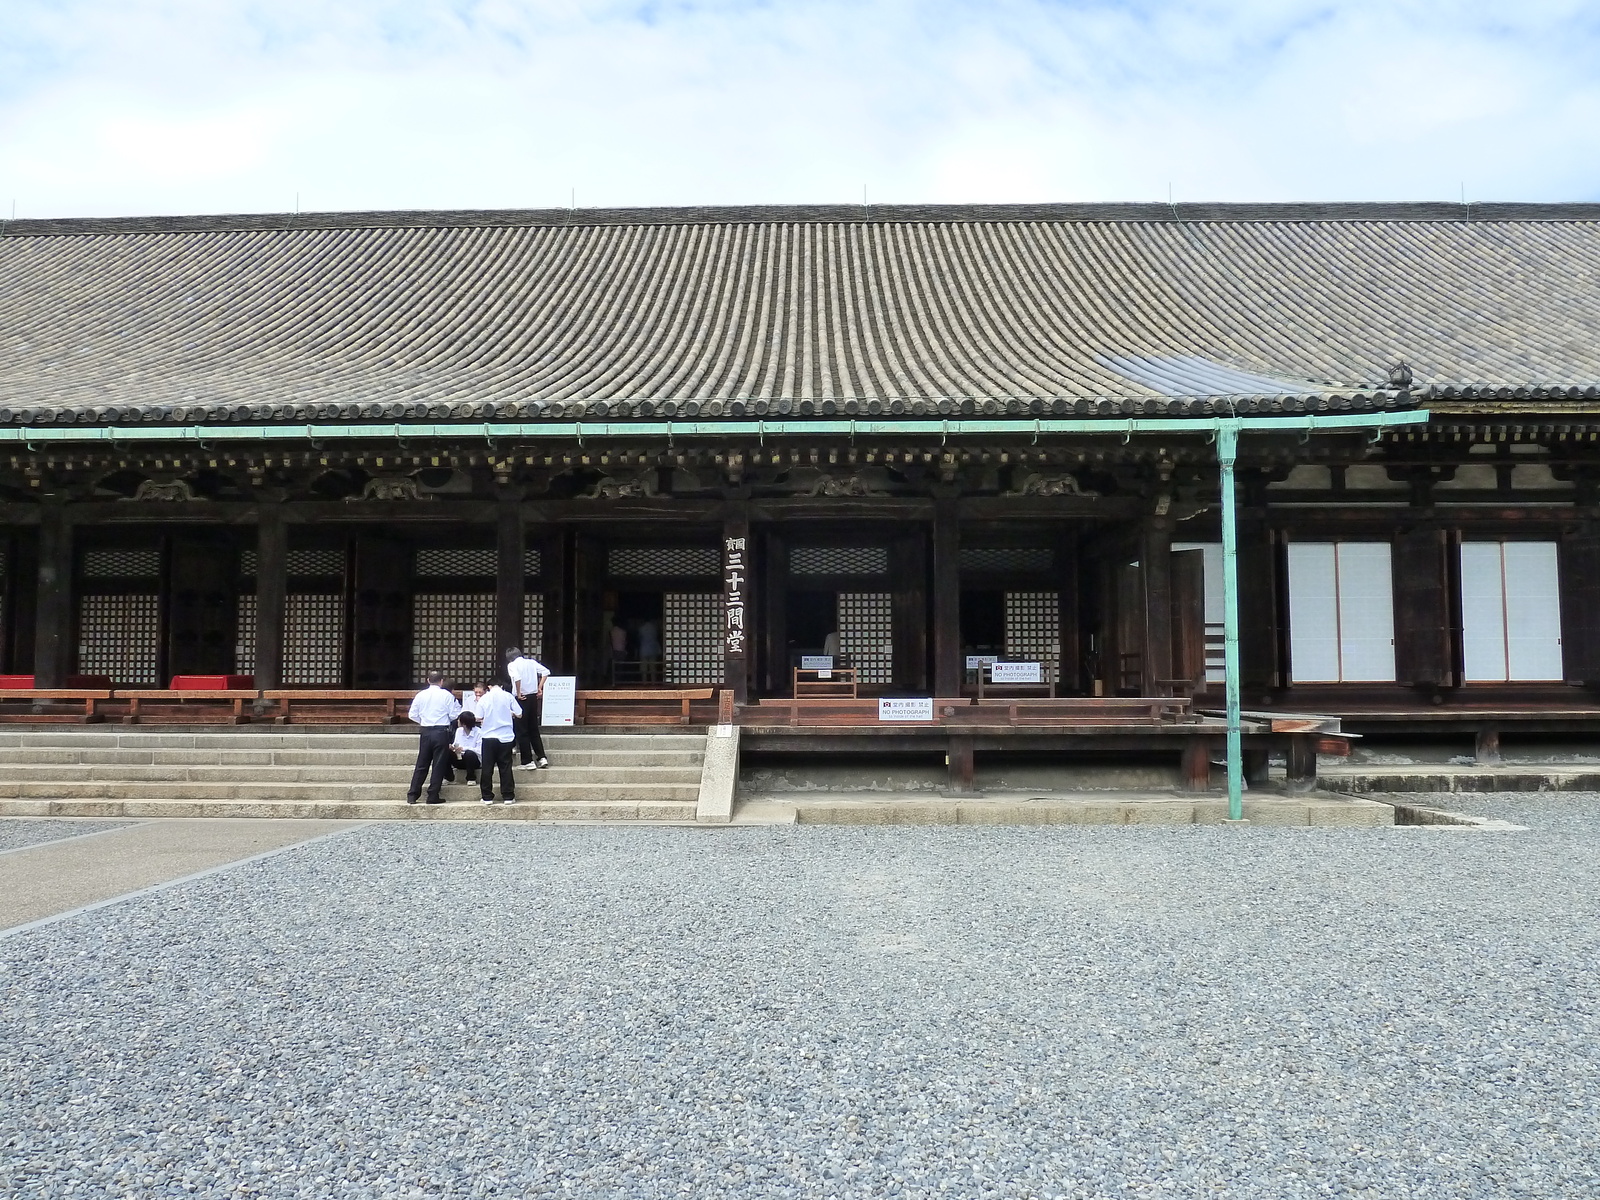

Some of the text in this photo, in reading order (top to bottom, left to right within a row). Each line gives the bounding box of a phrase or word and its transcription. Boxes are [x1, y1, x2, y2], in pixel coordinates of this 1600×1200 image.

[725, 553, 745, 653] 三十三間堂
